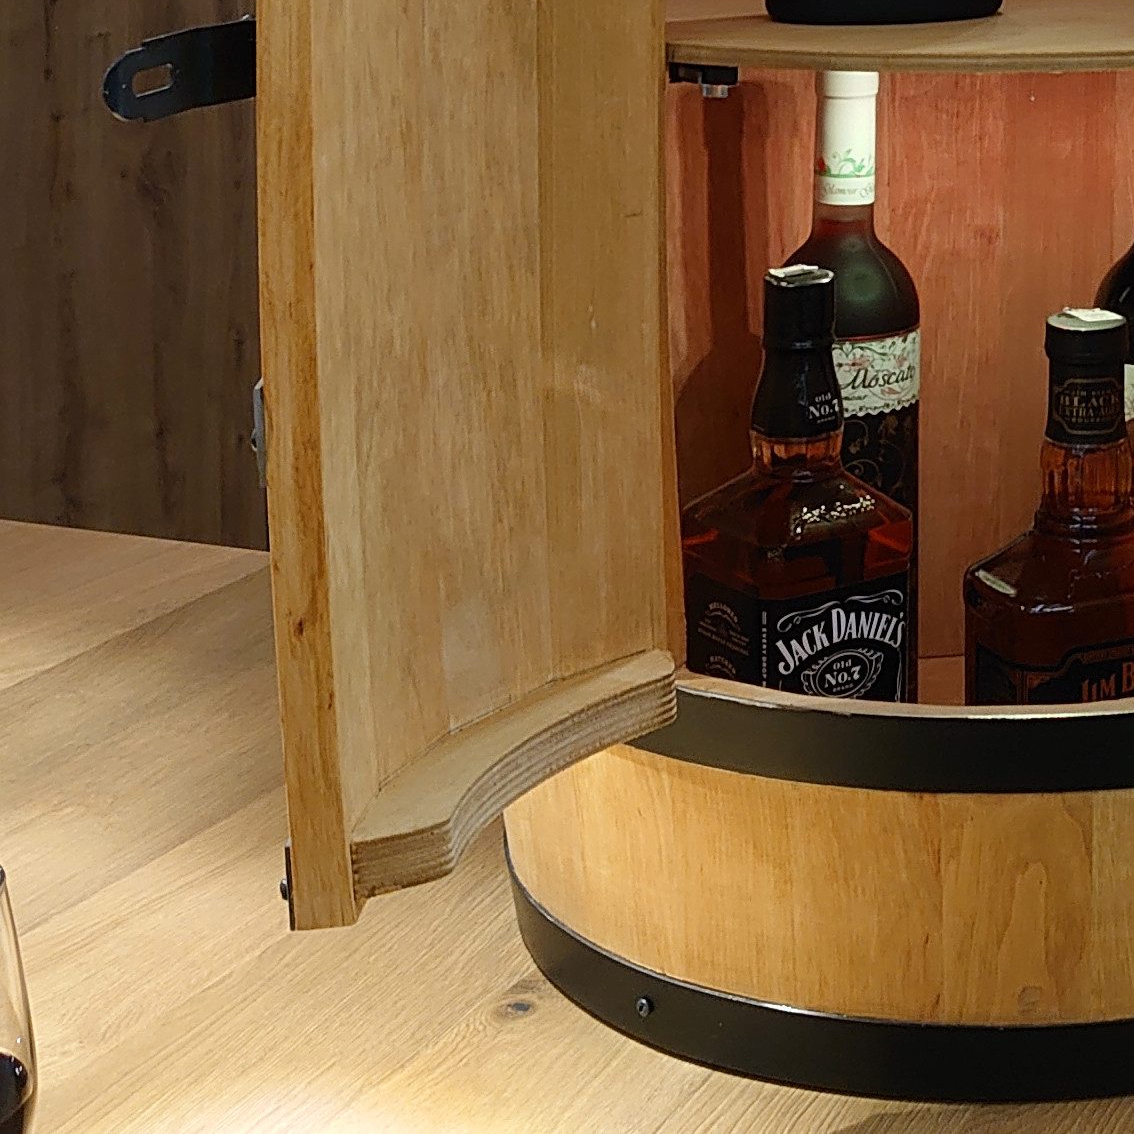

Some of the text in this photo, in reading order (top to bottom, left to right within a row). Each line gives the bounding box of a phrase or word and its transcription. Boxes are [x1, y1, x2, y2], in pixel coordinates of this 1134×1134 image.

[815, 391, 832, 403] Old
[775, 620, 830, 675] JACK
[831, 607, 906, 648] DANIEL'S
[833, 659, 852, 670] Old
[824, 665, 862, 688] No.7
